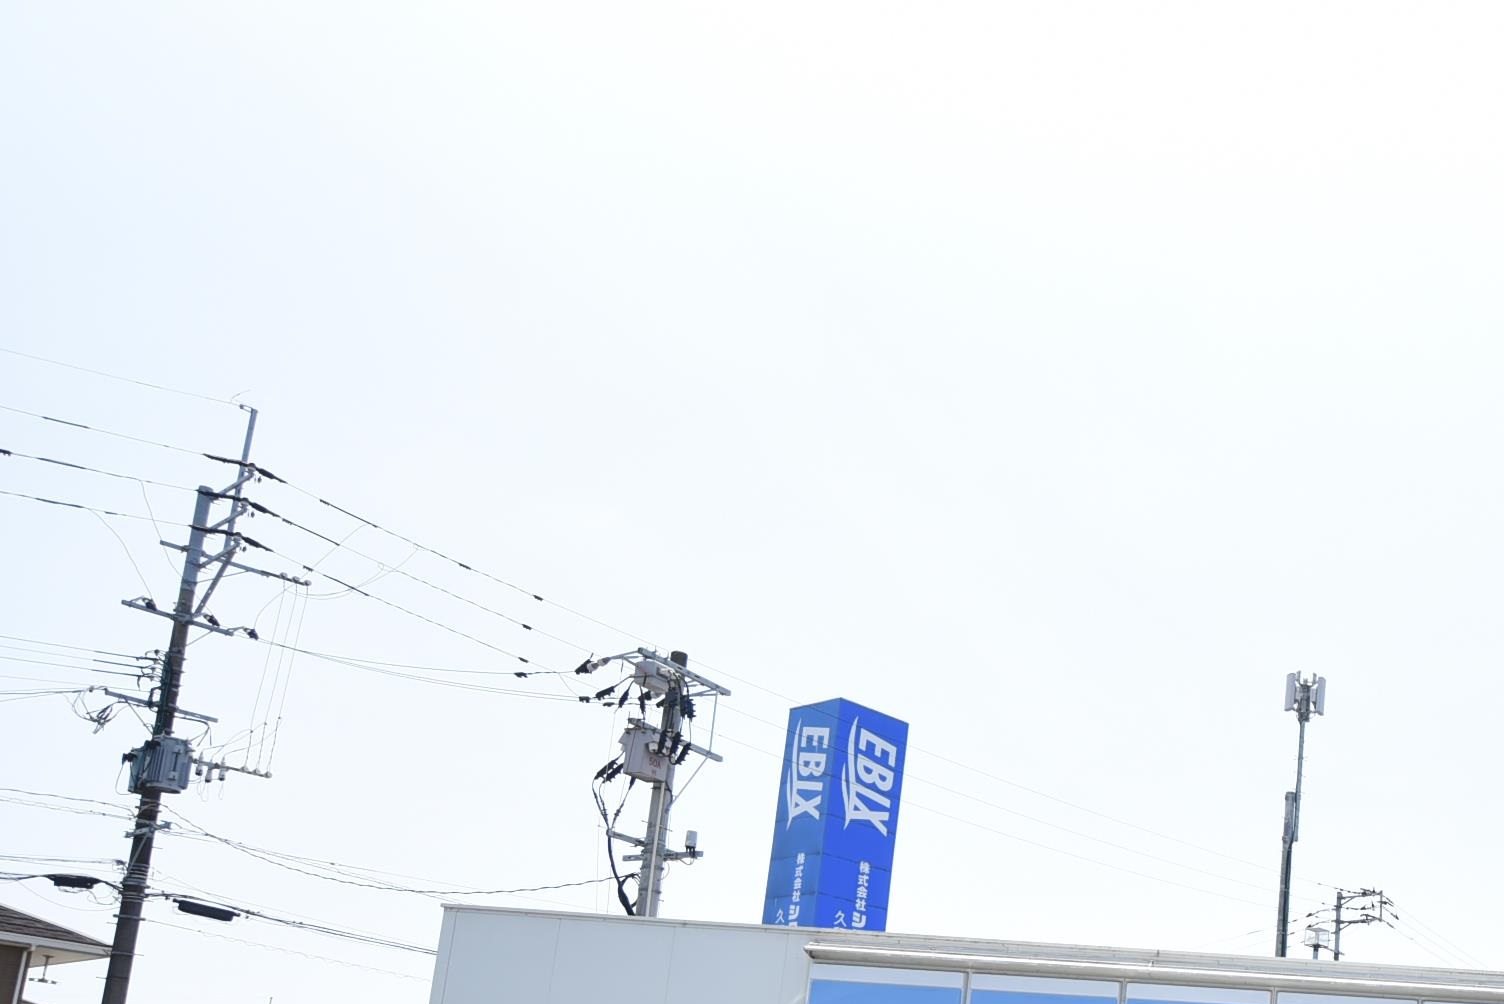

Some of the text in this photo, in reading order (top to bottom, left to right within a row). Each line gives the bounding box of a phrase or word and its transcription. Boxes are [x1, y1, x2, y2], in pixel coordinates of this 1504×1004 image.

[790, 726, 831, 821] EBIX
[848, 727, 898, 838] EBIX
[851, 861, 870, 929] 株式会社シ
